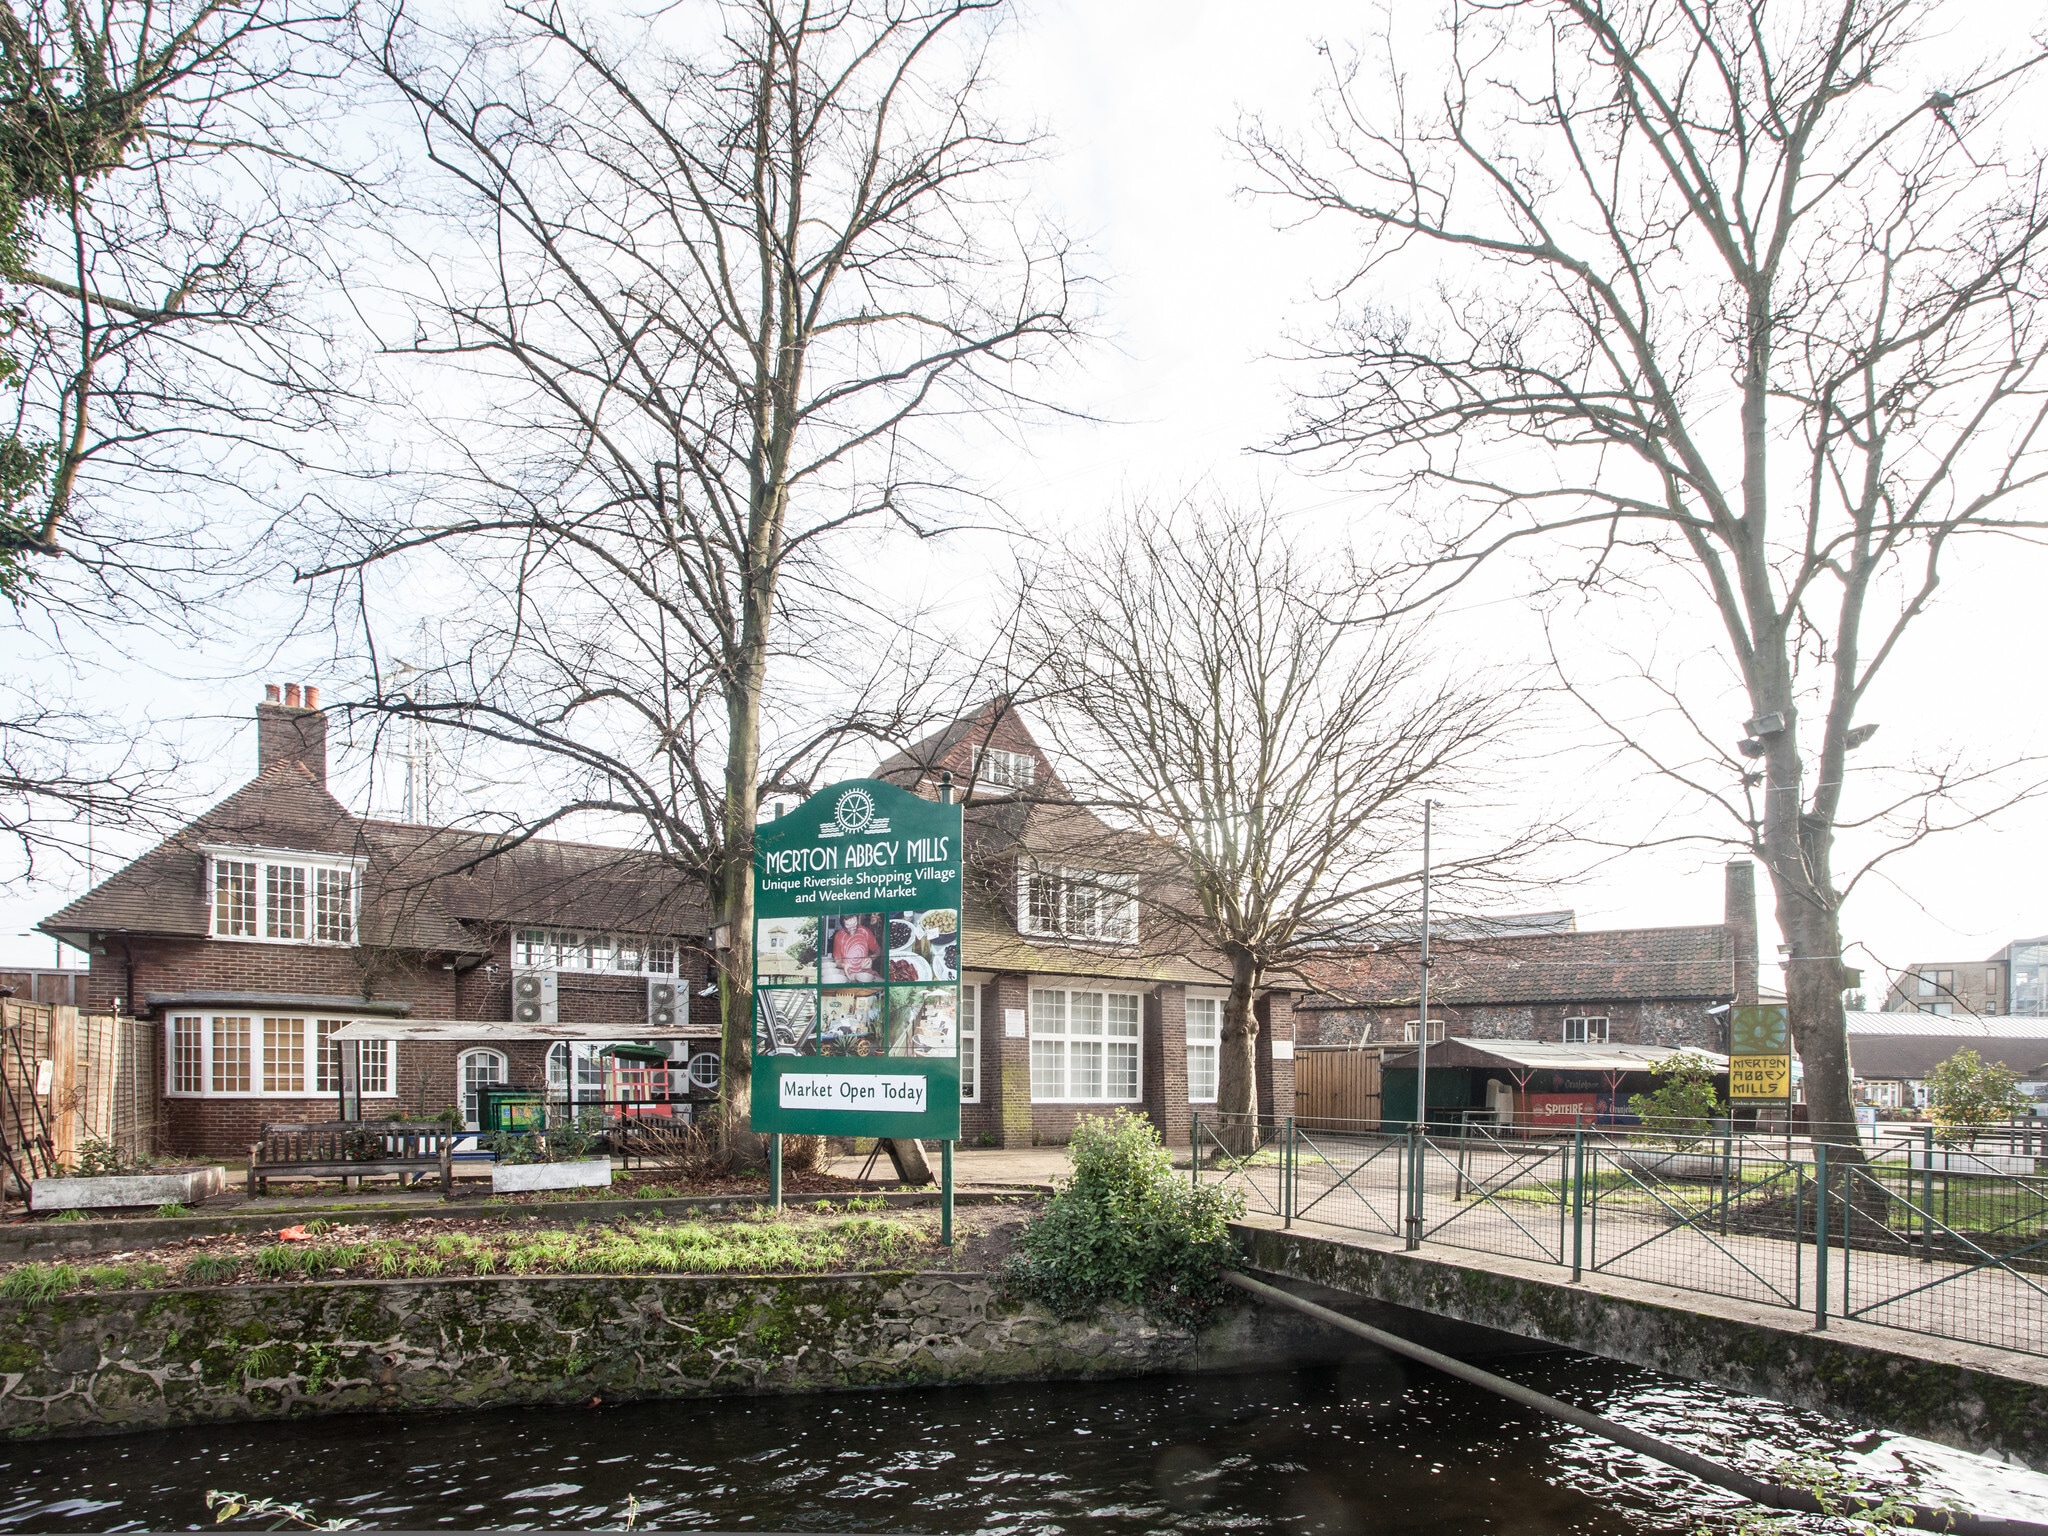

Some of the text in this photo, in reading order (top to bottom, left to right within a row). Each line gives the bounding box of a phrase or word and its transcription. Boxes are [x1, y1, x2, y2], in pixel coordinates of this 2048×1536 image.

[766, 836, 949, 874] MERTON ABBEY MILLS
[762, 867, 955, 892] Unique Riverside Shopping Village
[795, 885, 917, 903] and Weekend Market
[1733, 1059, 1786, 1068] MERTON
[1733, 1071, 1786, 1080] ABBEY
[784, 1080, 923, 1105] Market Open Today
[1733, 1083, 1778, 1094] MILLS
[1545, 1103, 1583, 1116] SPITFIRE
